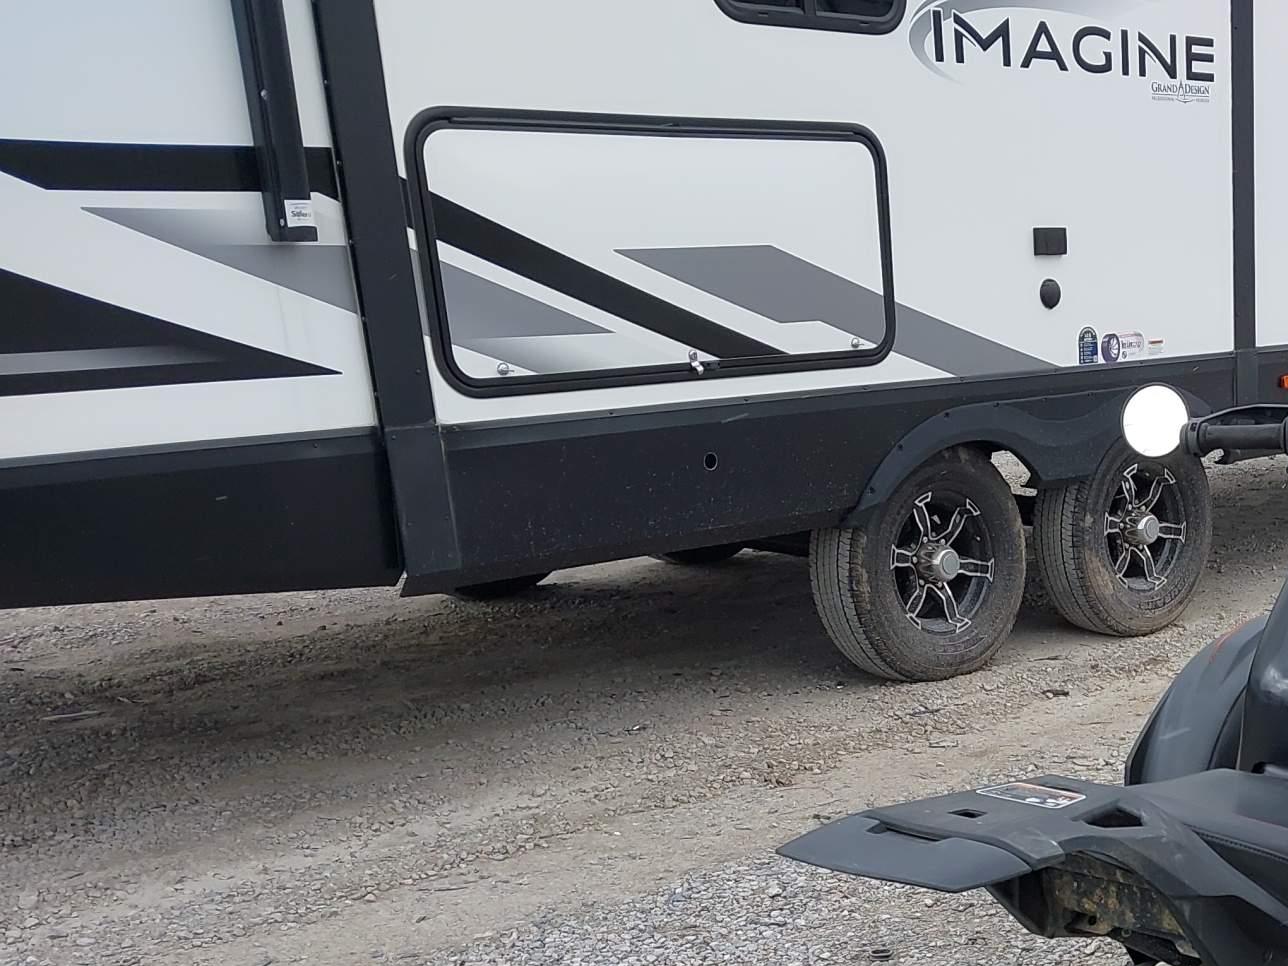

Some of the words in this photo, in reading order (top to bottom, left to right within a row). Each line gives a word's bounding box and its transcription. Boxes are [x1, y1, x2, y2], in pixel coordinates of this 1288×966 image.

[931, 8, 1215, 83] IMAGINE
[1151, 81, 1178, 94] GRAND
[1184, 83, 1210, 95] DESIGN
